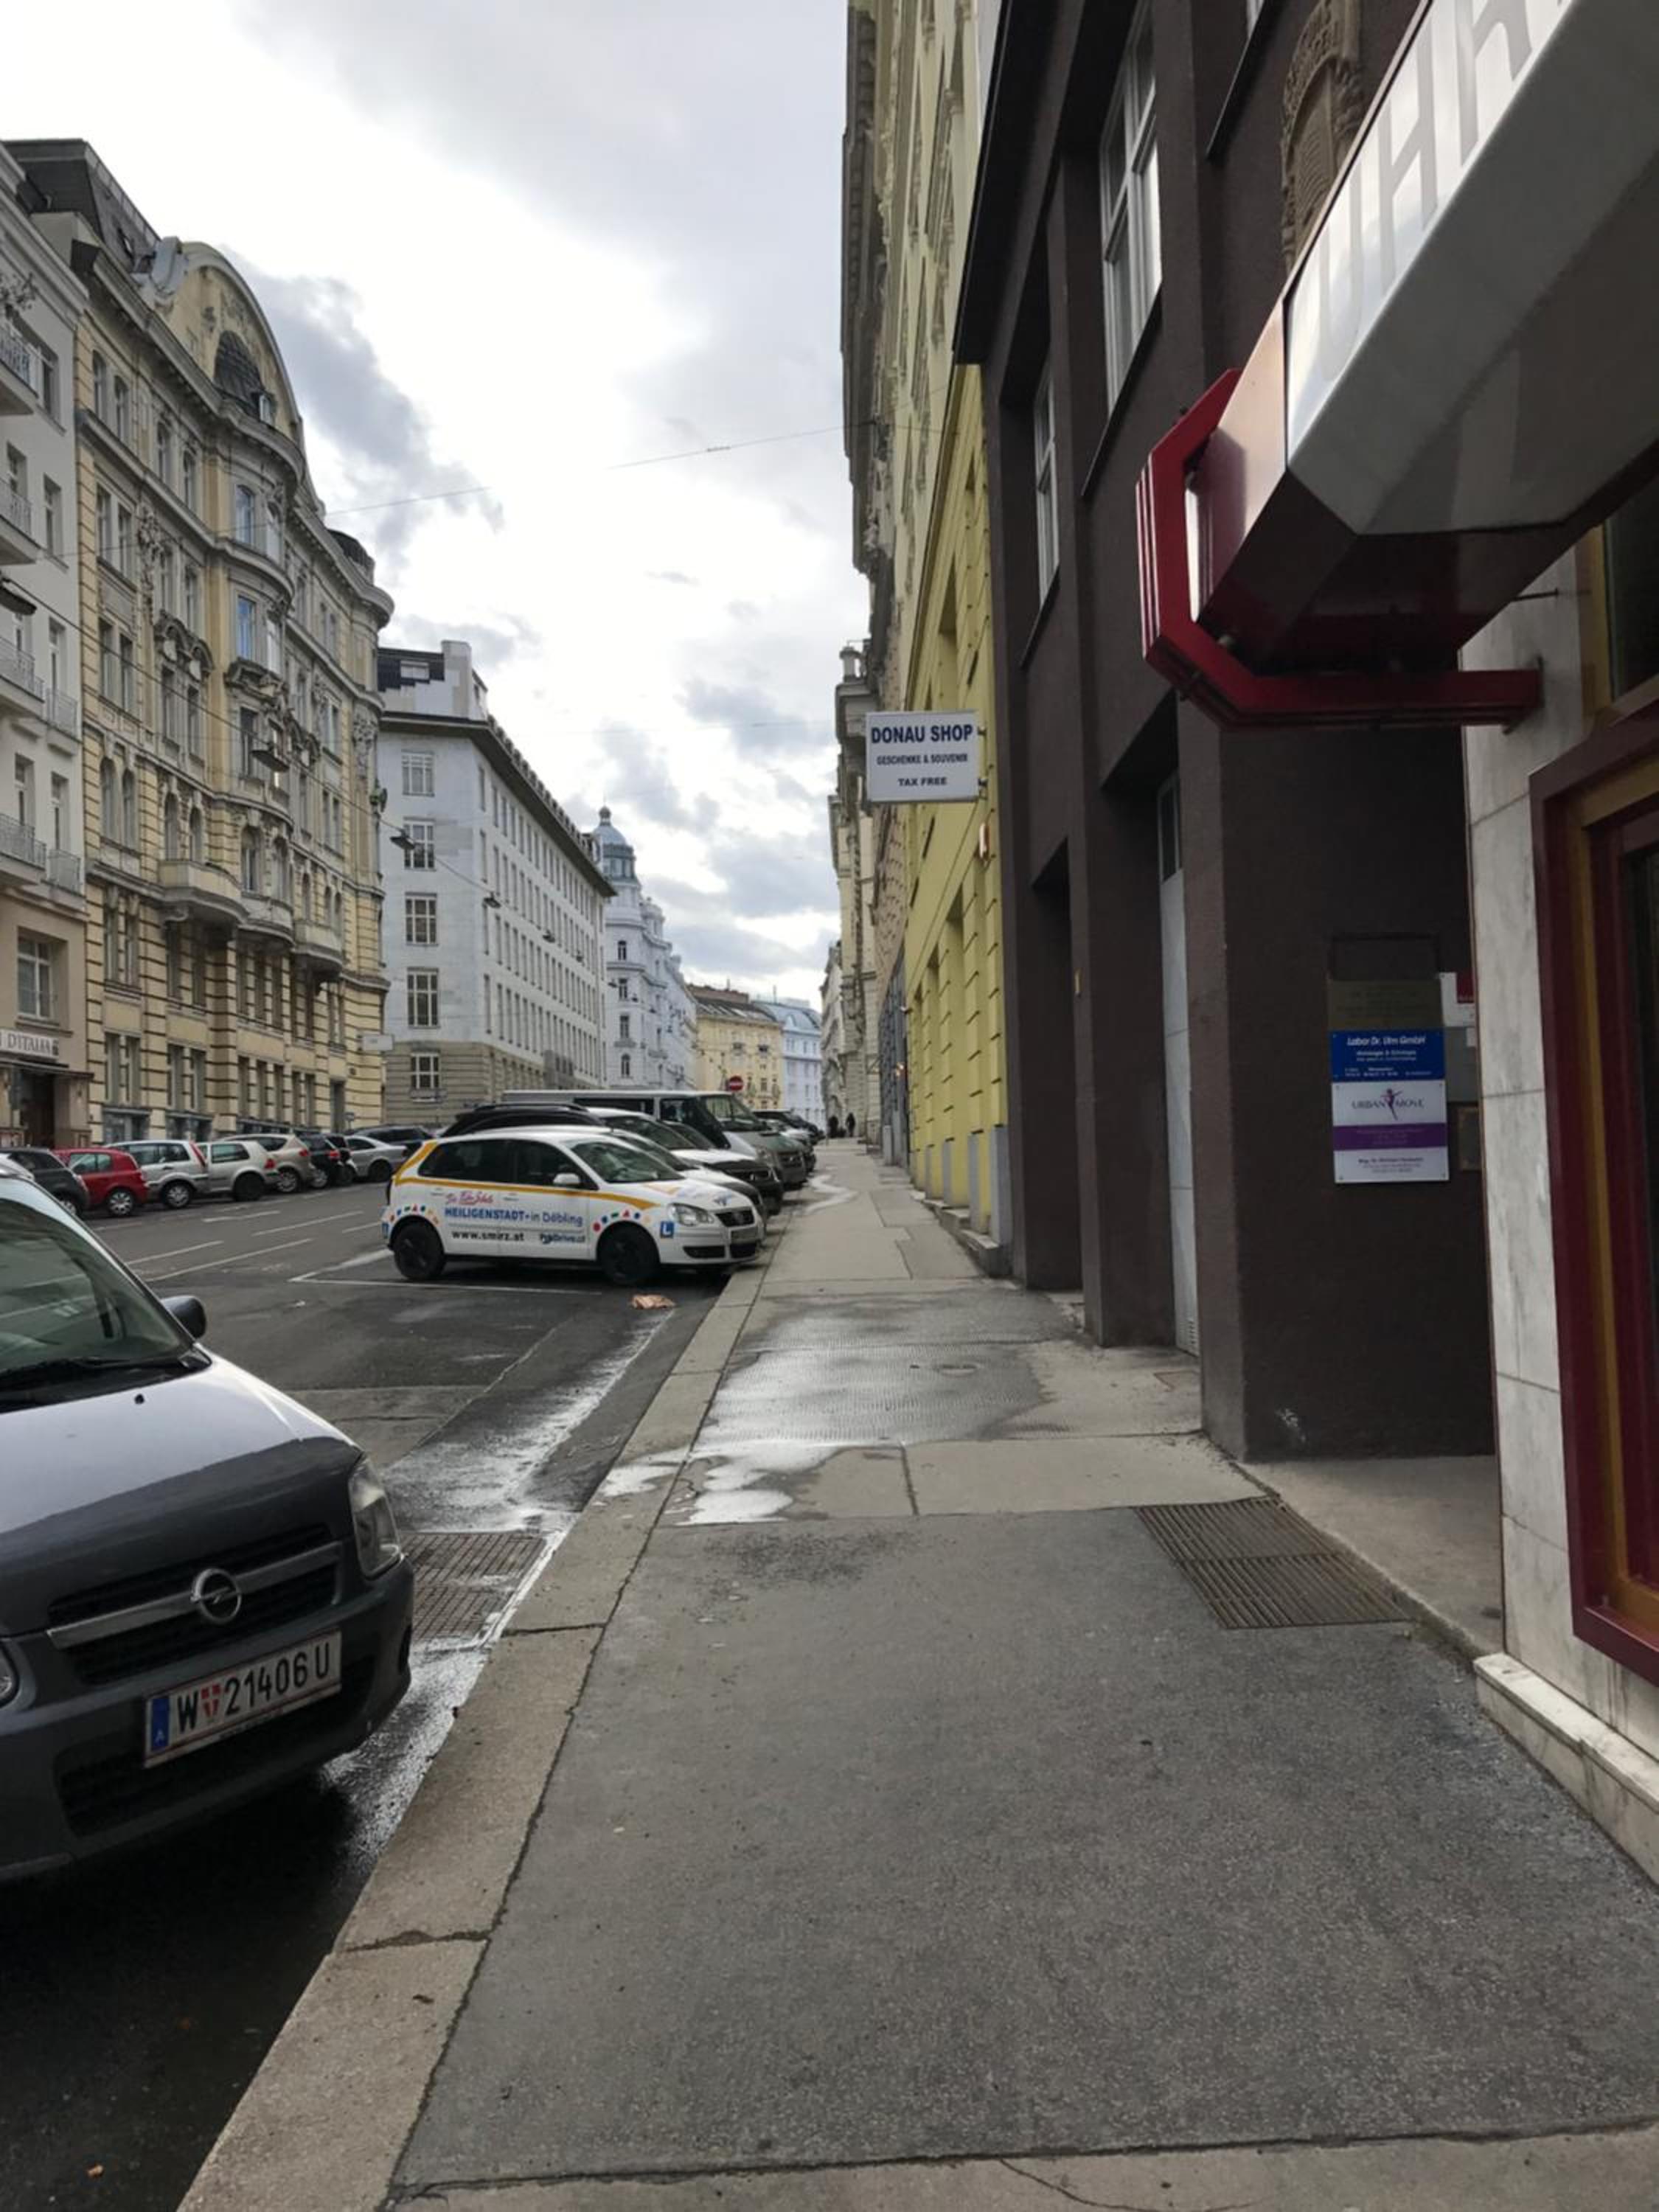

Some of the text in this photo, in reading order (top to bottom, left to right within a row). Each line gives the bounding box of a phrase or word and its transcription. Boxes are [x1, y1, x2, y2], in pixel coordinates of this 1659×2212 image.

[871, 724, 973, 743] DONAU SHOP
[877, 755, 921, 765] GESCHENKE
[923, 754, 929, 763] &
[898, 776, 947, 787] TAX FREE
[445, 1207, 583, 1227] HEILIGENSTADT in Döbling
[177, 1691, 199, 1733] W
[223, 1651, 307, 1716] 21406
[315, 1641, 330, 1679] U
